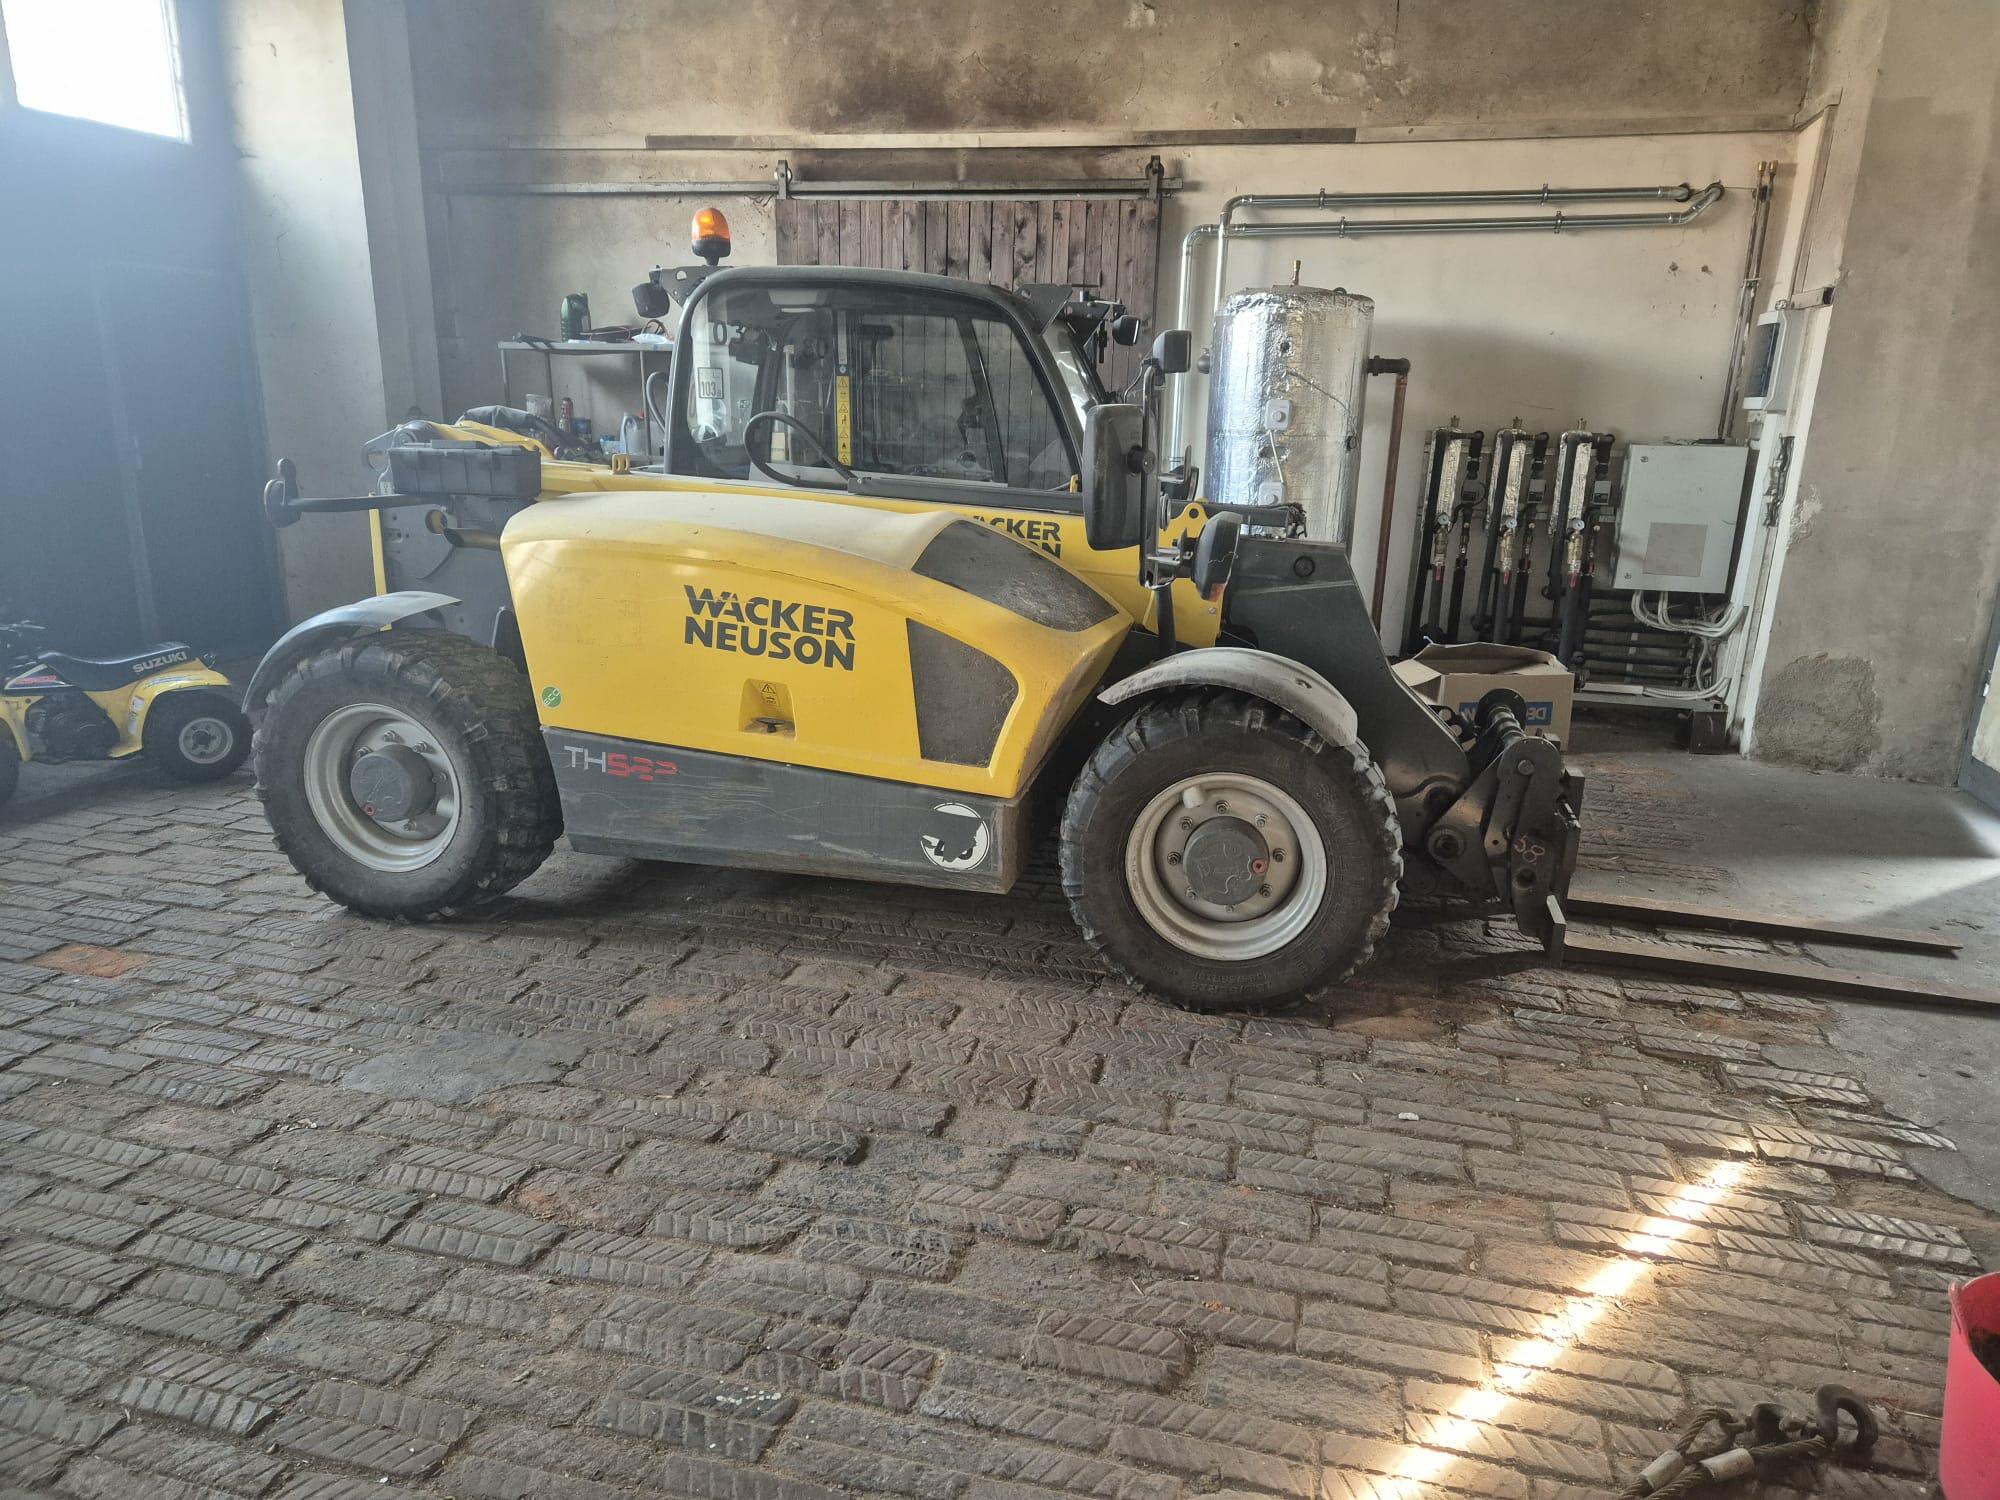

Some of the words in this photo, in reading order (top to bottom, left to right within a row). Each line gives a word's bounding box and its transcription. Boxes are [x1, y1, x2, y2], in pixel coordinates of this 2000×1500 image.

[683, 584, 855, 641] WACKER
[132, 651, 188, 673] SUZUKI
[684, 615, 855, 671] NEUSON
